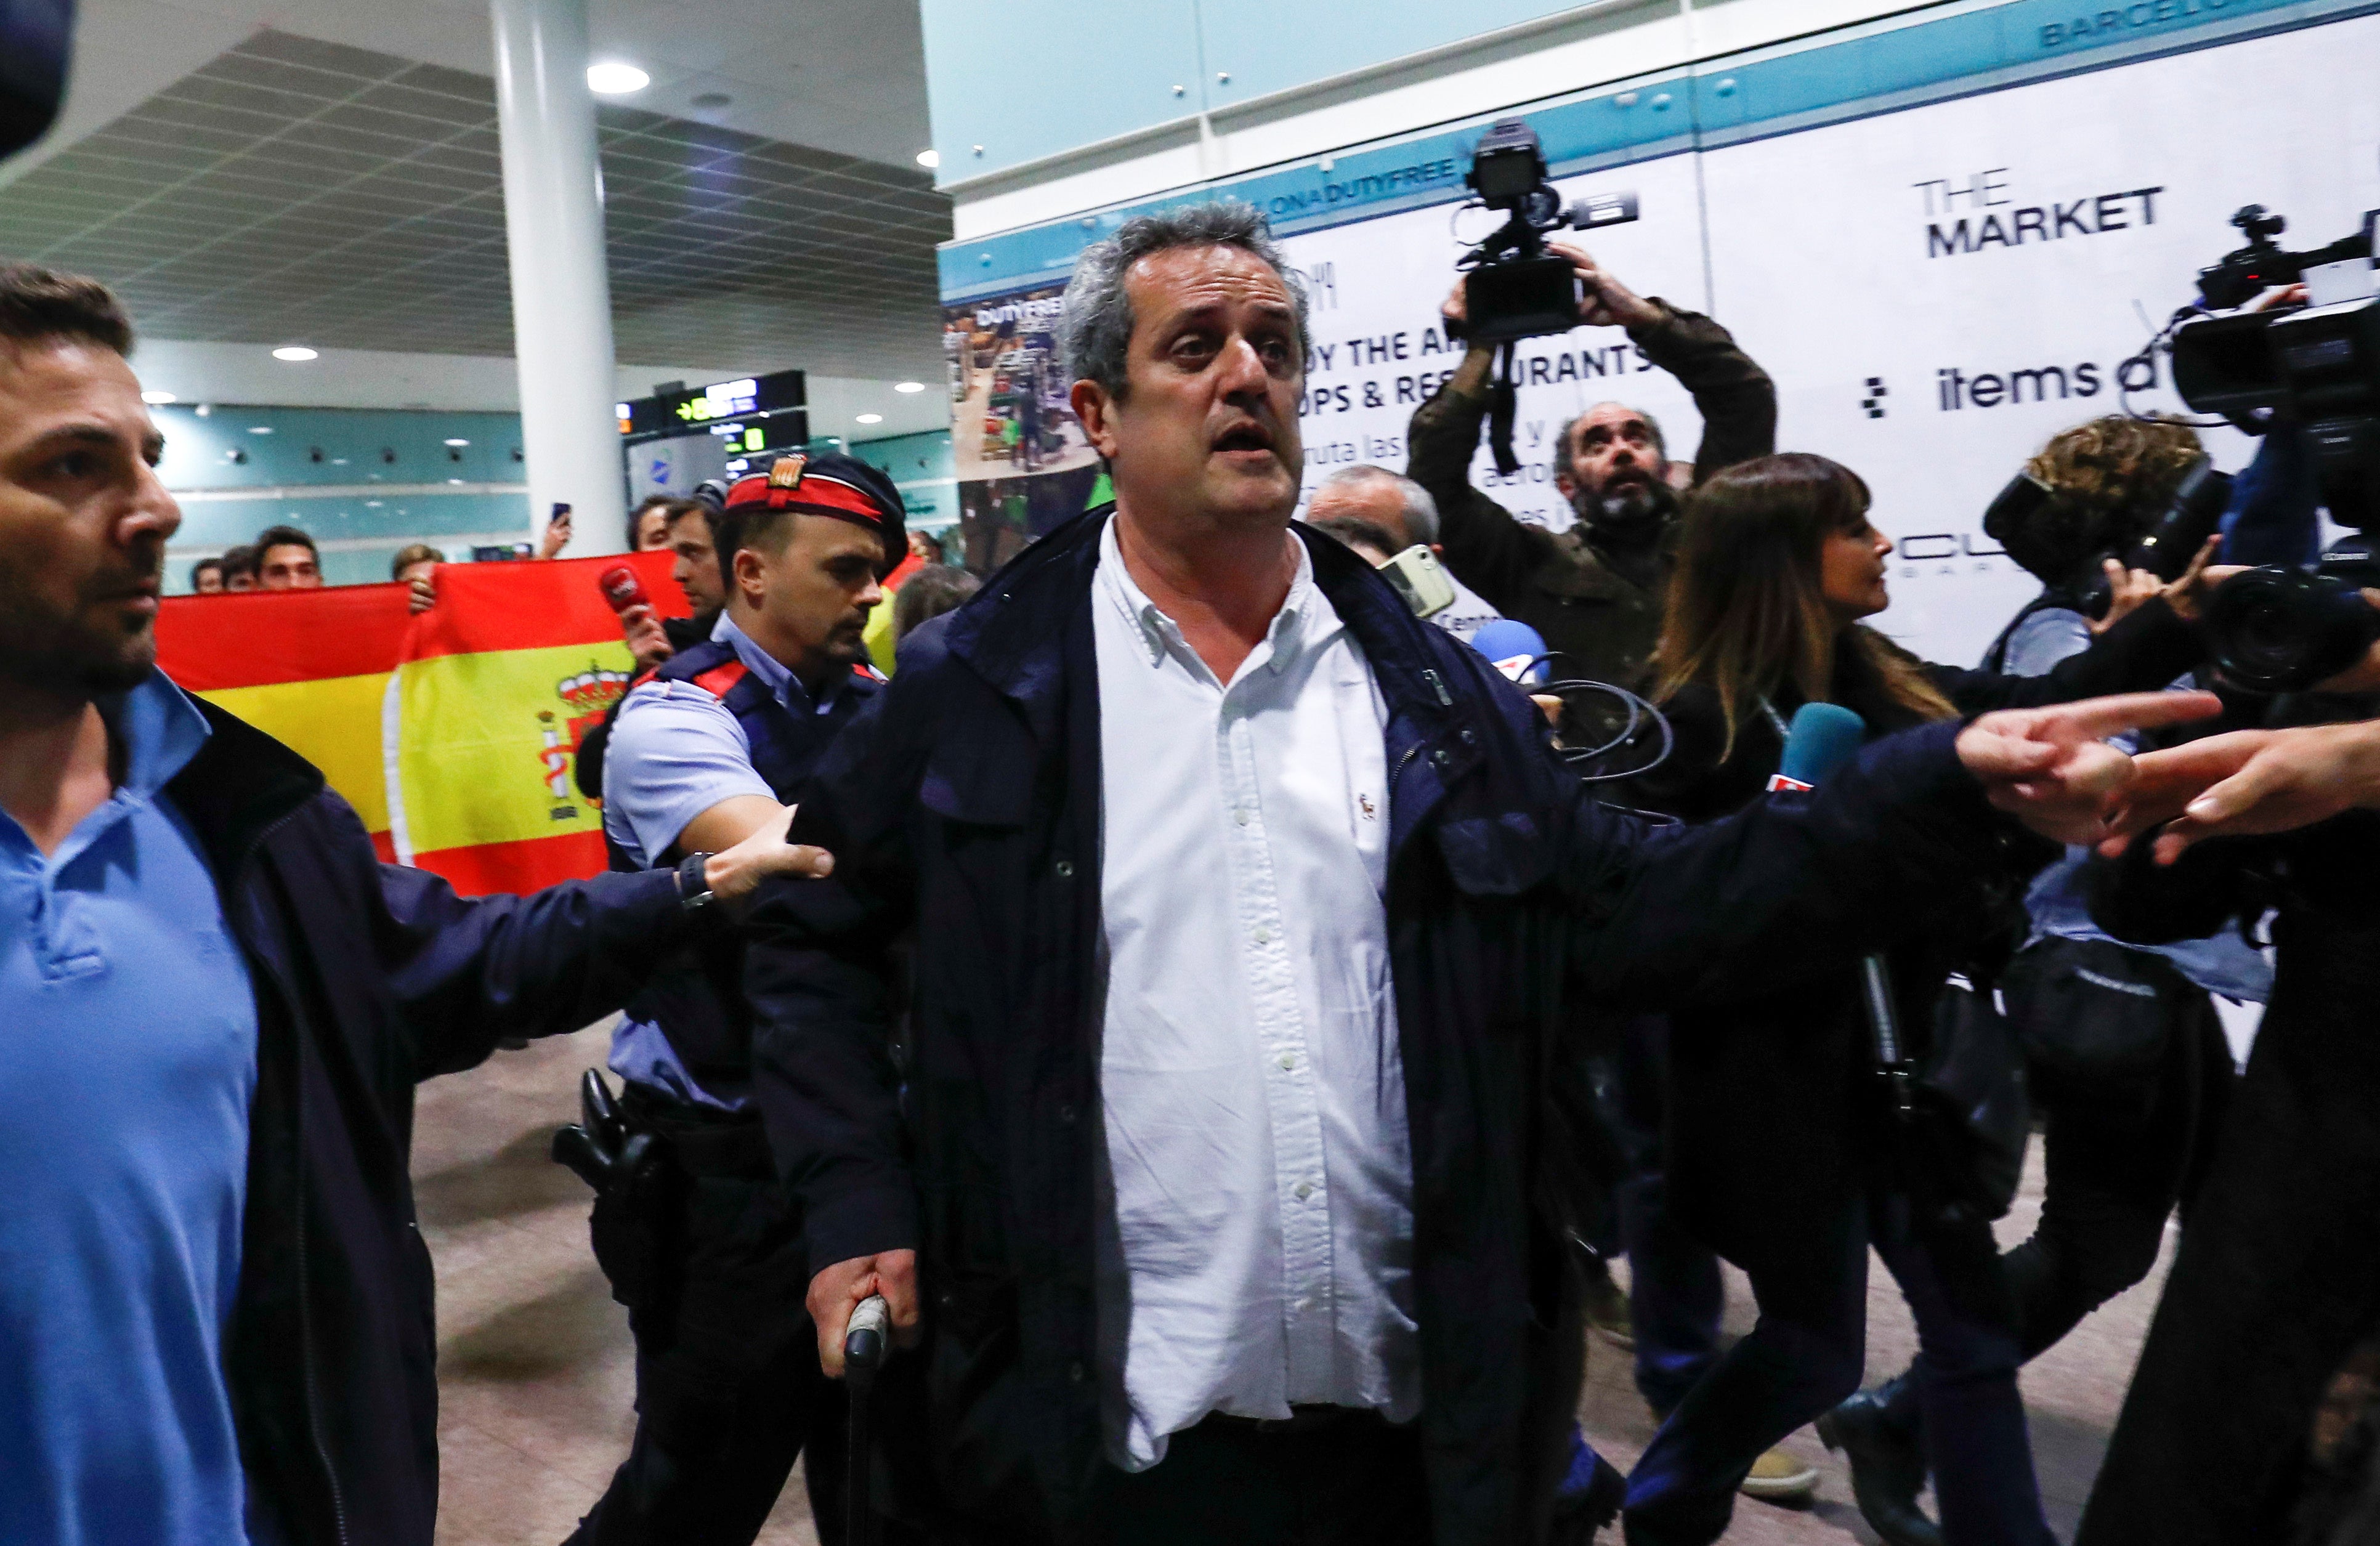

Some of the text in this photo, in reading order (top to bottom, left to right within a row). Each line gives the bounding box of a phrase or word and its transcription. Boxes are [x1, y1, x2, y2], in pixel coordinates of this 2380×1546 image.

[1269, 158, 1455, 214] ONADUTYFREE
[1911, 168, 2011, 216] THE
[1926, 185, 2166, 258] MARKET
[1347, 331, 1409, 366] THE
[1362, 381, 1386, 408] &
[1938, 362, 2102, 411] items
[1362, 434, 1400, 460] las
[1525, 419, 1546, 448] y
